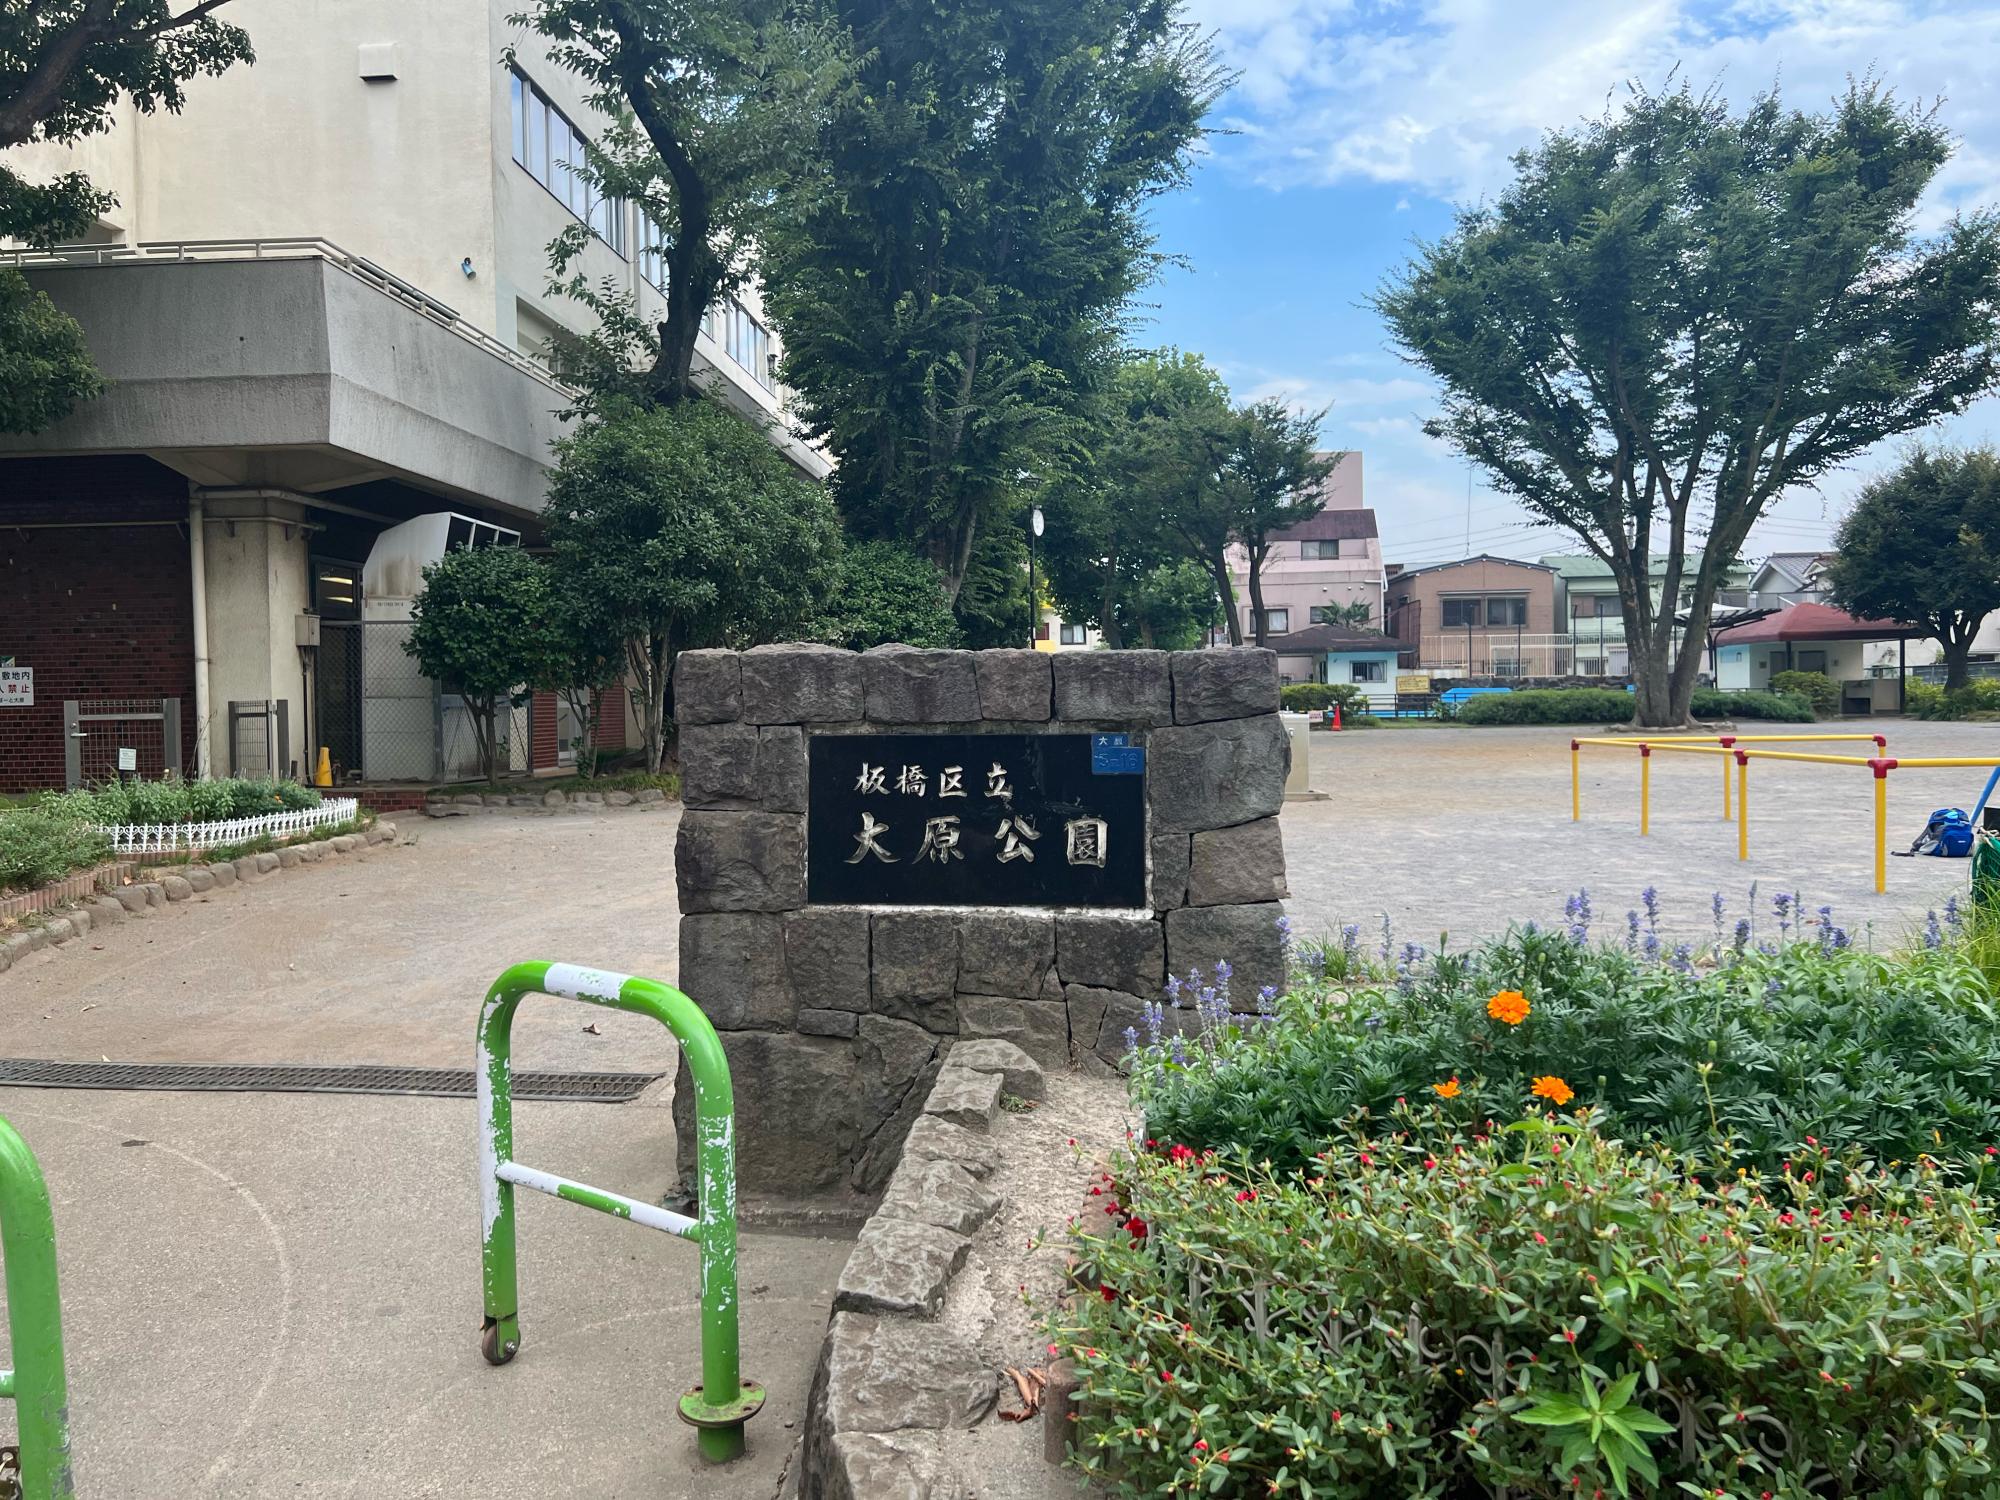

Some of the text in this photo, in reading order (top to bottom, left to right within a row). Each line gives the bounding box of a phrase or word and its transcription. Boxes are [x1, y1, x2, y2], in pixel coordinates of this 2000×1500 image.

[854, 762, 1013, 798] 板橋区立
[844, 812, 1109, 868] 大原公園
